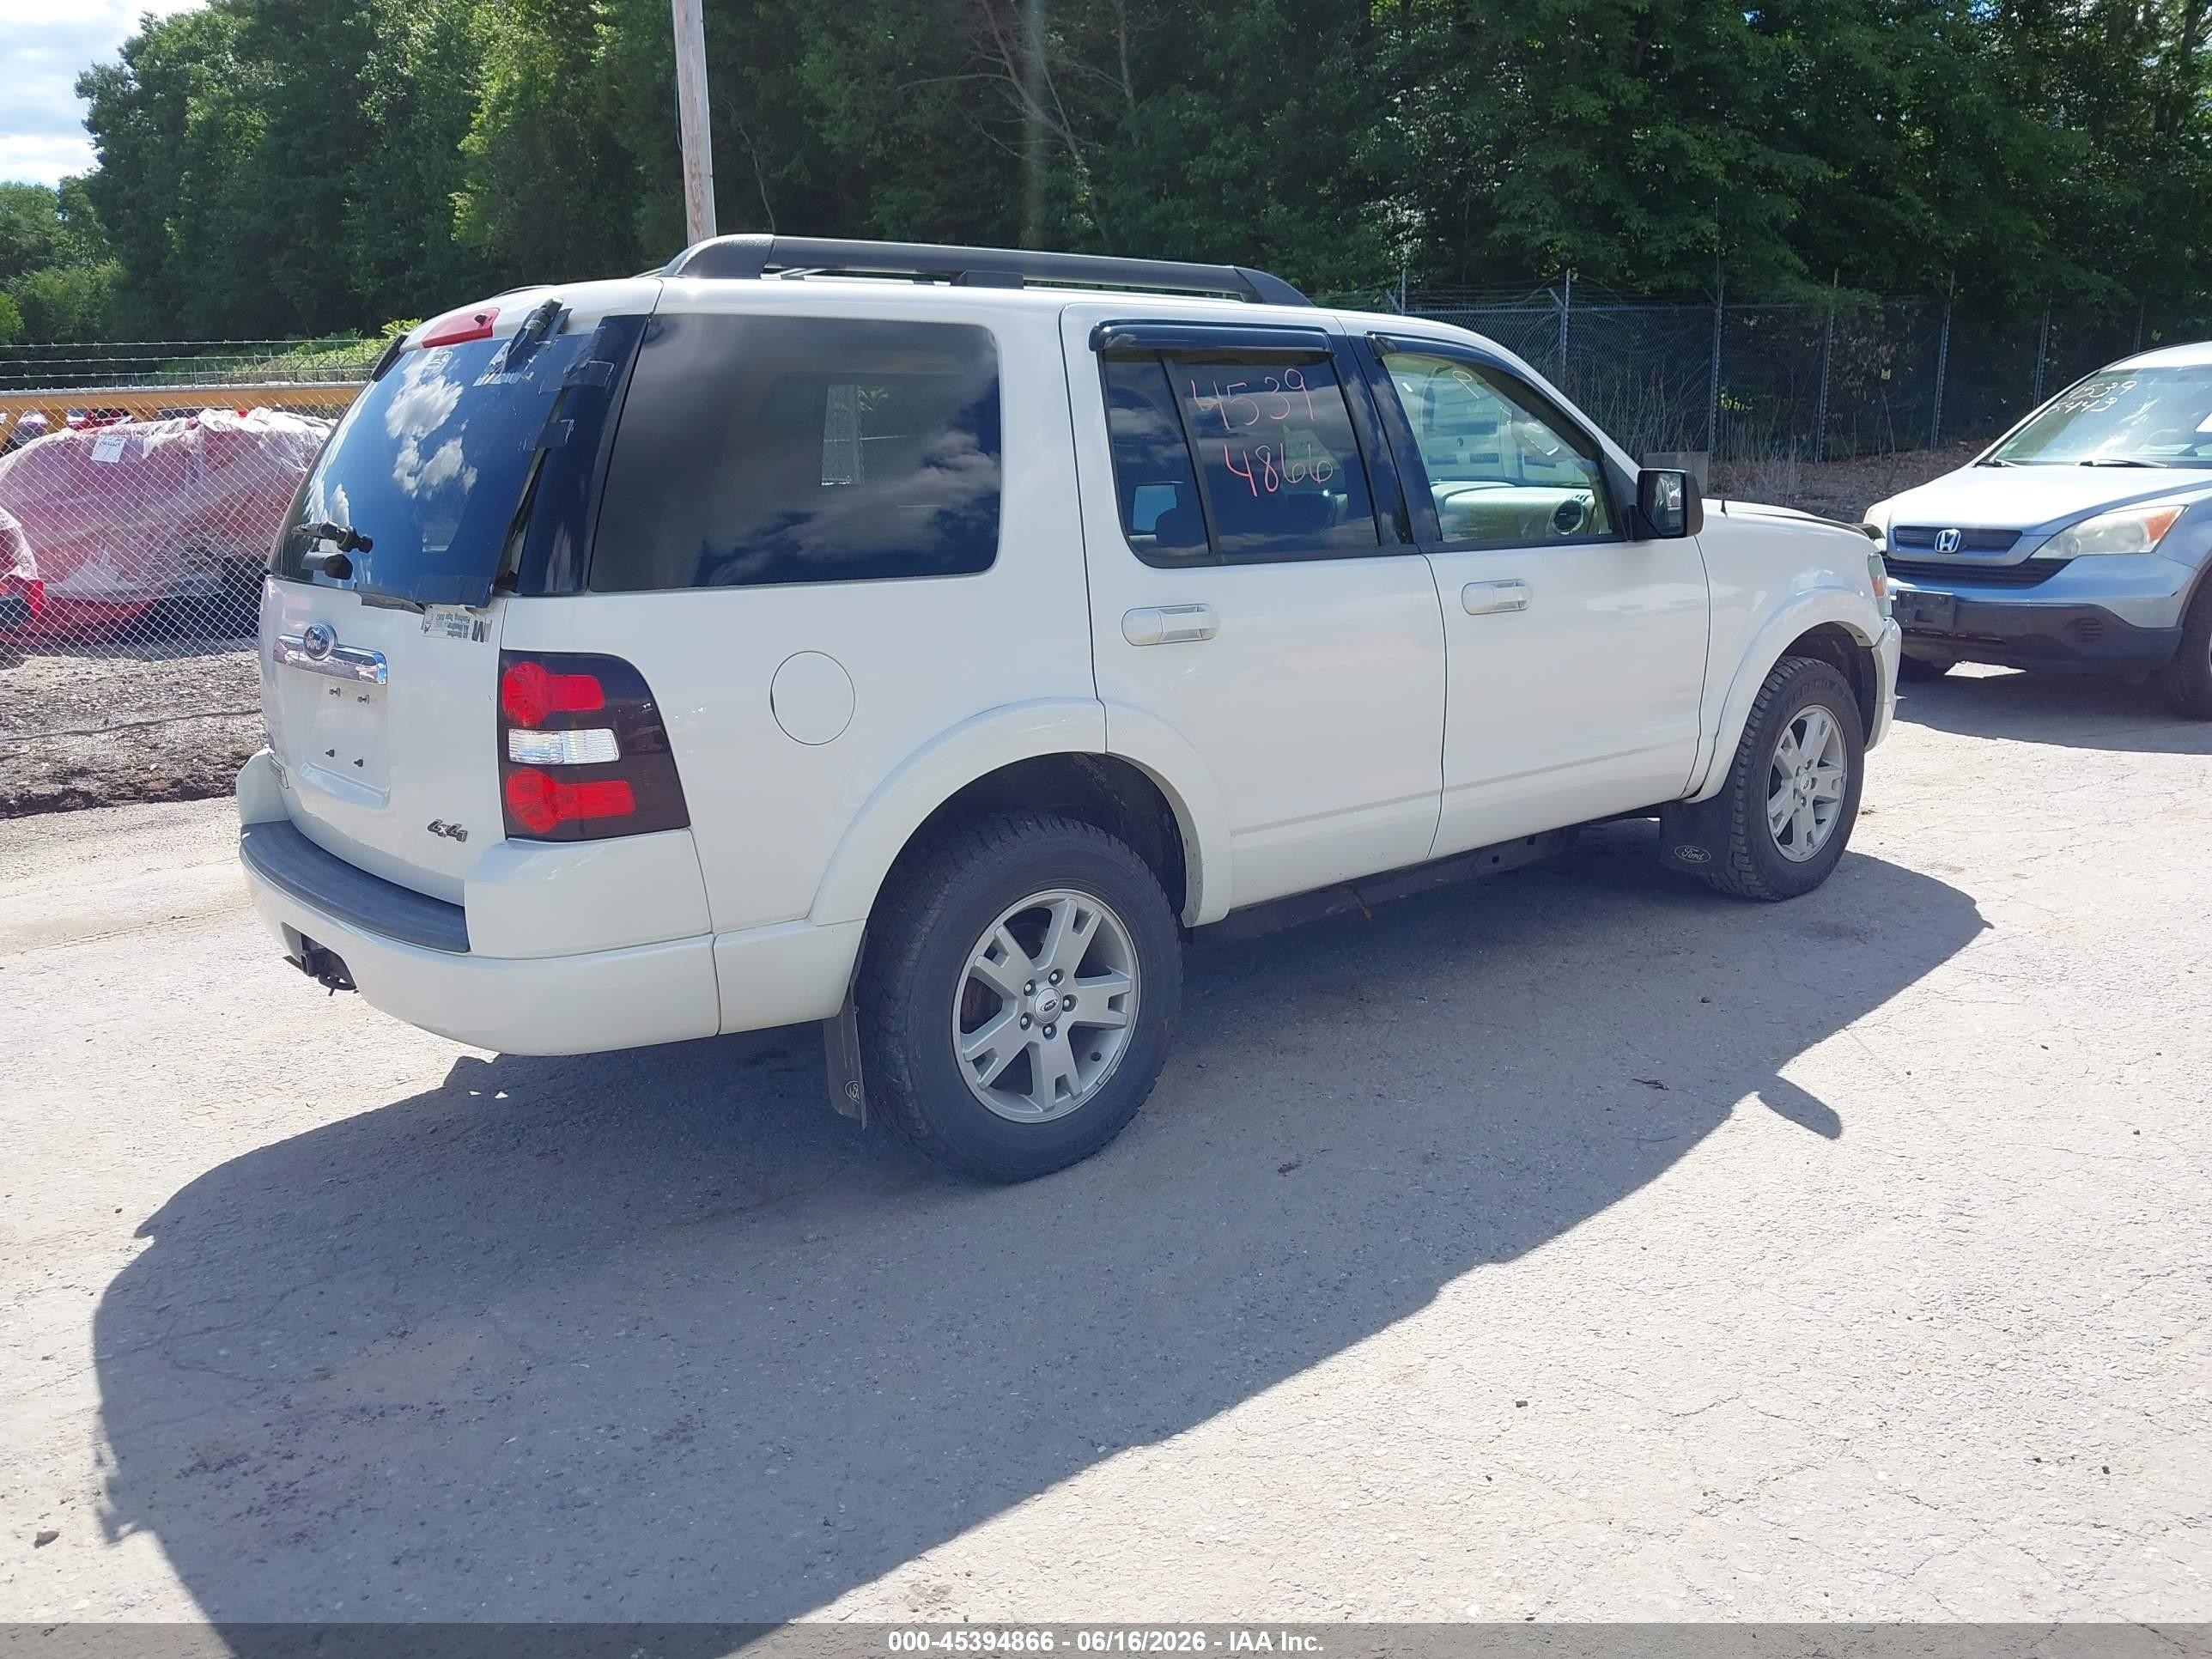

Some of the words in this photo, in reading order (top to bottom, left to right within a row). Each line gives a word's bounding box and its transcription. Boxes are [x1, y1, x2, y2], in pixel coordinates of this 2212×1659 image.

[1190, 368, 1315, 430] 4539
[2068, 380, 2137, 399] 4539
[1224, 441, 1334, 498] 4866
[1681, 847, 1705, 860] Ford
